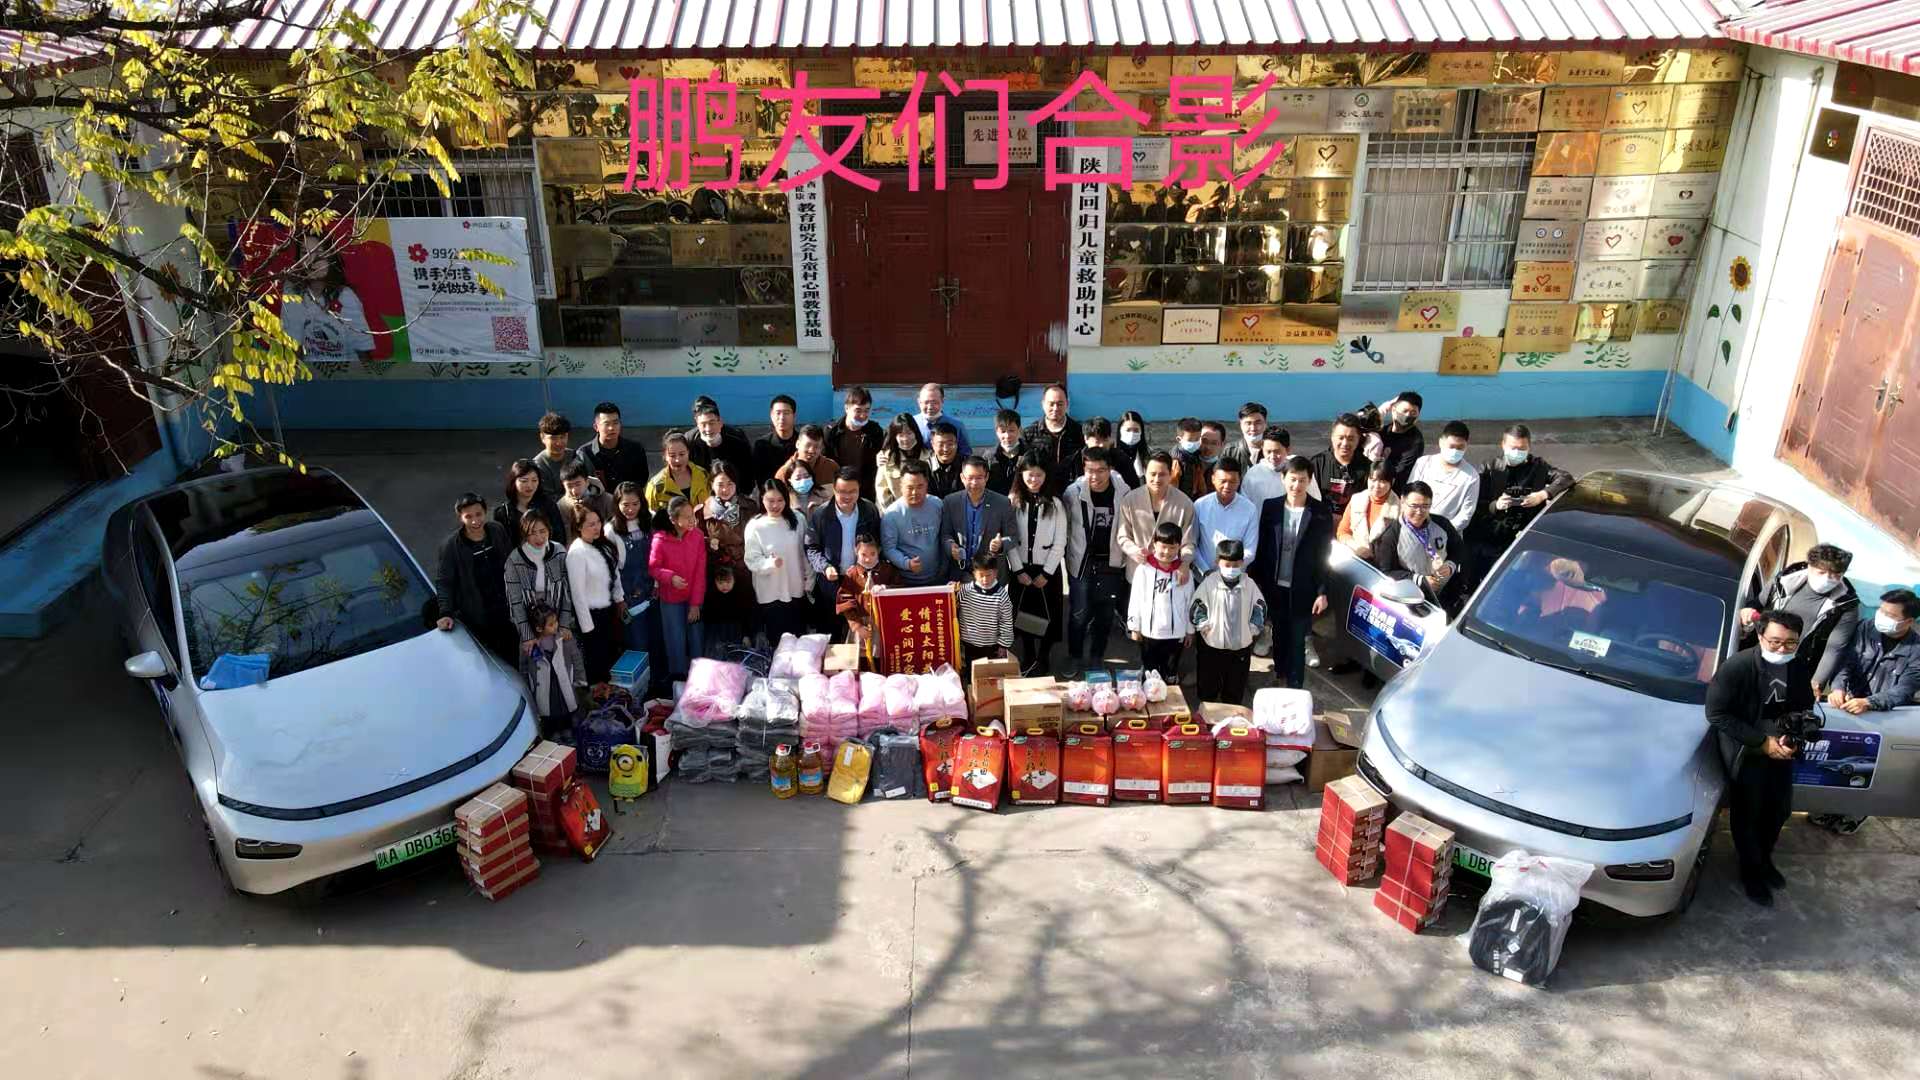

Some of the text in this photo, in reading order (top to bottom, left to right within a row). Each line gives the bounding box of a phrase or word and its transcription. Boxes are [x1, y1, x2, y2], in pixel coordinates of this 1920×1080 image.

[414, 267, 472, 281] 携手何洁
[797, 202, 823, 338] 教育研究会儿童村心理教育基地
[1074, 157, 1101, 336] 陕西回归儿童救助中心
